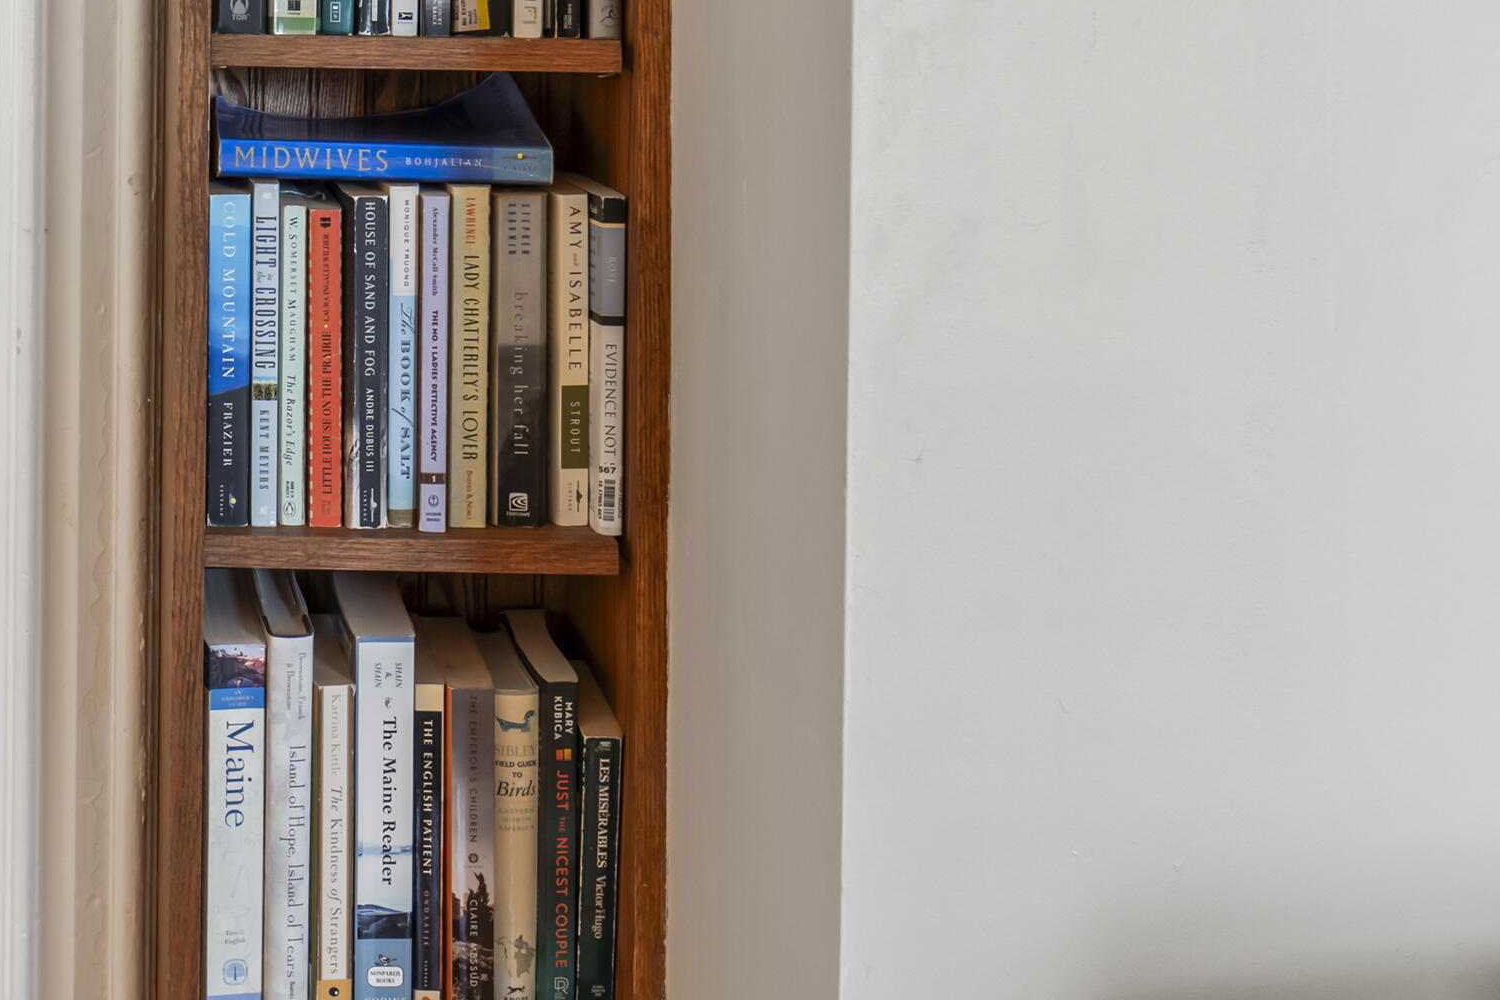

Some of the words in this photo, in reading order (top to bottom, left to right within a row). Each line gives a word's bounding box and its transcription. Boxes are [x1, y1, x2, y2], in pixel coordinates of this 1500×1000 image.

[234, 145, 389, 172] MIDWIVES
[405, 156, 483, 168] BOHJALIAN
[222, 201, 237, 258] COLD
[289, 216, 299, 229] W.
[364, 201, 376, 246] HOUSE
[431, 206, 440, 245] Alexander
[465, 196, 477, 245] LAWRENCE
[288, 233, 299, 294] SOMERSET
[364, 251, 376, 269] OF
[432, 246, 440, 272] McCall
[463, 255, 480, 290] LADY
[364, 274, 376, 311] SAND
[431, 273, 439, 297] Smith
[221, 268, 236, 379] MOUNTAIN
[287, 299, 298, 362] MAUGHAM
[364, 315, 376, 344] AND
[400, 302, 416, 336] The
[431, 309, 439, 326] THE
[507, 291, 528, 376] breaking
[322, 331, 333, 374] PRAIRIE
[431, 327, 439, 344] NO.
[462, 297, 480, 402] CHATTERLEY'S
[364, 349, 376, 377] FOG
[399, 339, 411, 402] BOOK
[431, 350, 439, 382] LADIES'
[603, 343, 618, 418] EVIDENCE
[286, 374, 297, 394] The
[322, 376, 333, 398] THE
[512, 384, 529, 415] her
[285, 397, 297, 437] Razor's
[322, 400, 333, 417] ON
[365, 387, 375, 421] ANDRE
[391, 406, 415, 428] of
[431, 383, 439, 427] DETECTIVE
[223, 402, 234, 467] FRAZIER
[259, 409, 270, 438] KENT
[322, 418, 333, 455] HOUSE
[365, 424, 375, 457] DUBUS
[461, 410, 479, 460] LOVER
[513, 423, 530, 456] fall
[569, 401, 581, 454] STROUT
[603, 425, 617, 457] NOT
[283, 440, 296, 466] Edge
[399, 426, 411, 479] SALT
[429, 427, 438, 462] AGENCY
[258, 445, 270, 490] MEYERS
[322, 457, 333, 495] LITTLE
[365, 460, 375, 473] III
[598, 466, 617, 474] 567
[374, 661, 382, 689] SHAIN
[384, 671, 392, 680] &
[395, 661, 404, 689] SHAIN
[469, 695, 478, 714] THE
[553, 695, 562, 741] KUBICA
[564, 701, 573, 735] MARY
[383, 716, 398, 751] The
[423, 719, 434, 745] THE
[288, 744, 306, 790] Island
[469, 720, 479, 783] EMPEROR'S
[495, 760, 515, 768] FIELD
[517, 760, 537, 768] GUIDE
[223, 719, 255, 828] Maine
[382, 757, 398, 814] Maine
[423, 752, 434, 812] ENGLISH
[497, 779, 537, 797] Birds
[598, 758, 610, 783] LES
[288, 795, 305, 811] of
[330, 786, 344, 813] The
[556, 769, 569, 811] JUST
[469, 788, 478, 843] CHILDREN
[558, 816, 566, 833] THE
[596, 785, 610, 869] MISÉRABLES
[279, 815, 305, 858] Hope,
[329, 817, 344, 885] Kindness
[382, 820, 398, 886] Reader
[422, 819, 434, 876] PATIENT
[555, 837, 569, 897] NICEST
[287, 863, 305, 907] Island
[327, 888, 343, 902] of
[595, 875, 607, 909] Victor
[287, 914, 304, 930] of
[469, 899, 479, 937] CLAIRE
[555, 903, 568, 968] COUPLE
[592, 908, 606, 940] Hugo
[286, 933, 305, 978] Tears
[324, 907, 342, 975] Strangers
[469, 942, 479, 987] MESSUD
